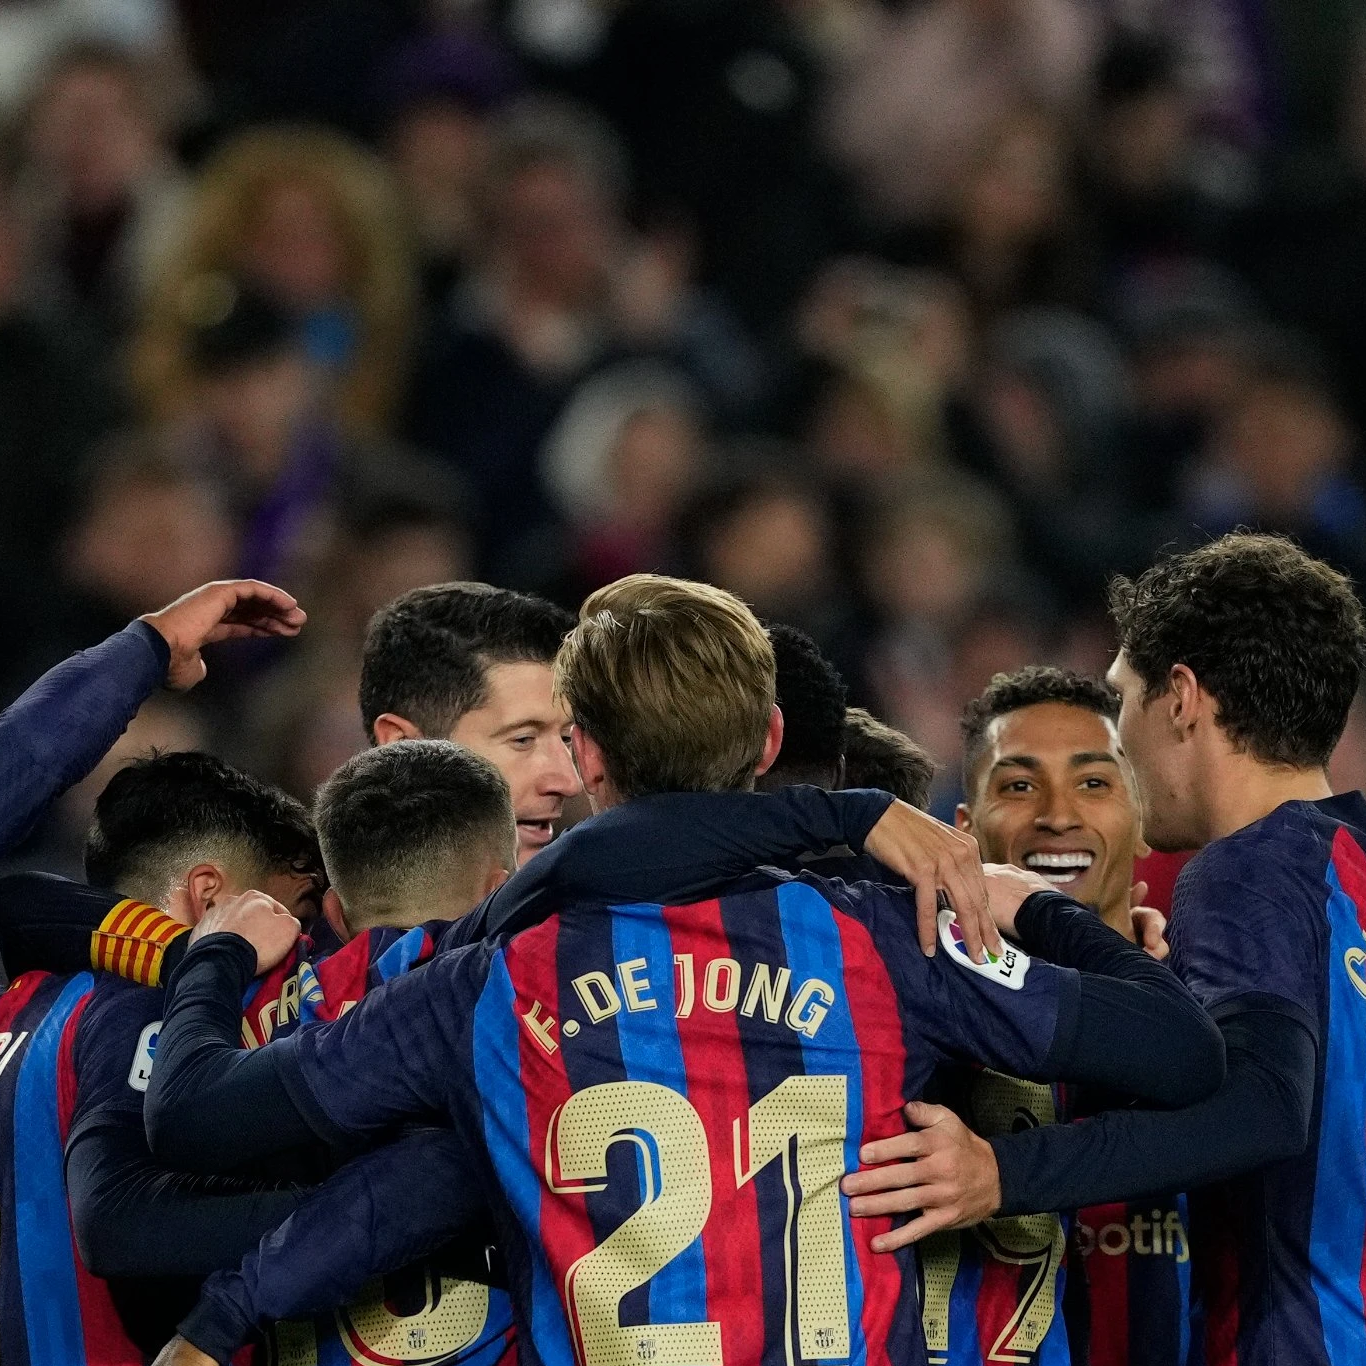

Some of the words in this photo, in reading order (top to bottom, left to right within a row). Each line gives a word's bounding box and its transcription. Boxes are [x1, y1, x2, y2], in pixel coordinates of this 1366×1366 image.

[521, 999, 581, 1056] F.
[570, 957, 659, 1026] DE
[673, 953, 836, 1040] JONG
